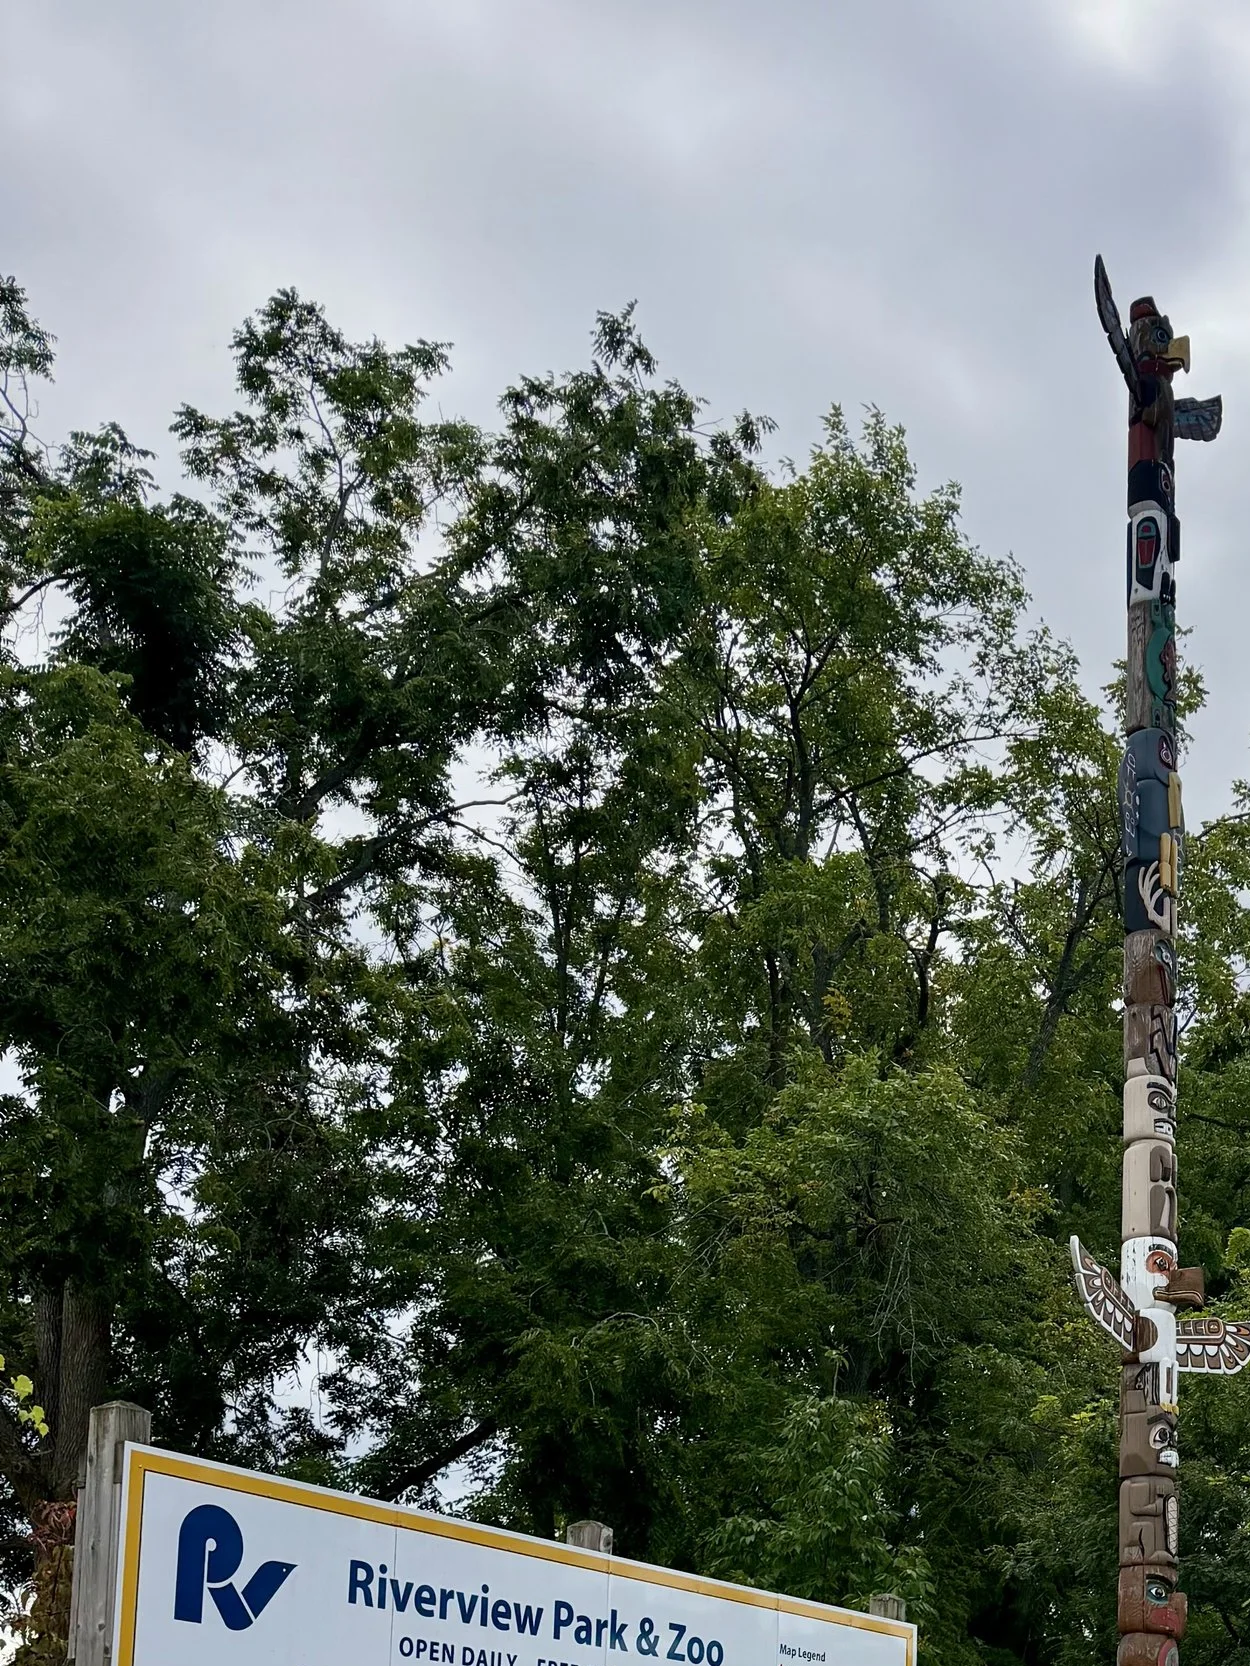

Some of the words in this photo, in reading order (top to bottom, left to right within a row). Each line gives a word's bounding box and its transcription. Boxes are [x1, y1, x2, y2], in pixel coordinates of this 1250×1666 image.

[348, 1560, 544, 1636] Riverview
[553, 1600, 628, 1652] Park
[636, 1617, 660, 1657] &
[399, 1637, 455, 1664] OPEN
[780, 1644, 796, 1658] Map
[798, 1648, 826, 1662] Legend
